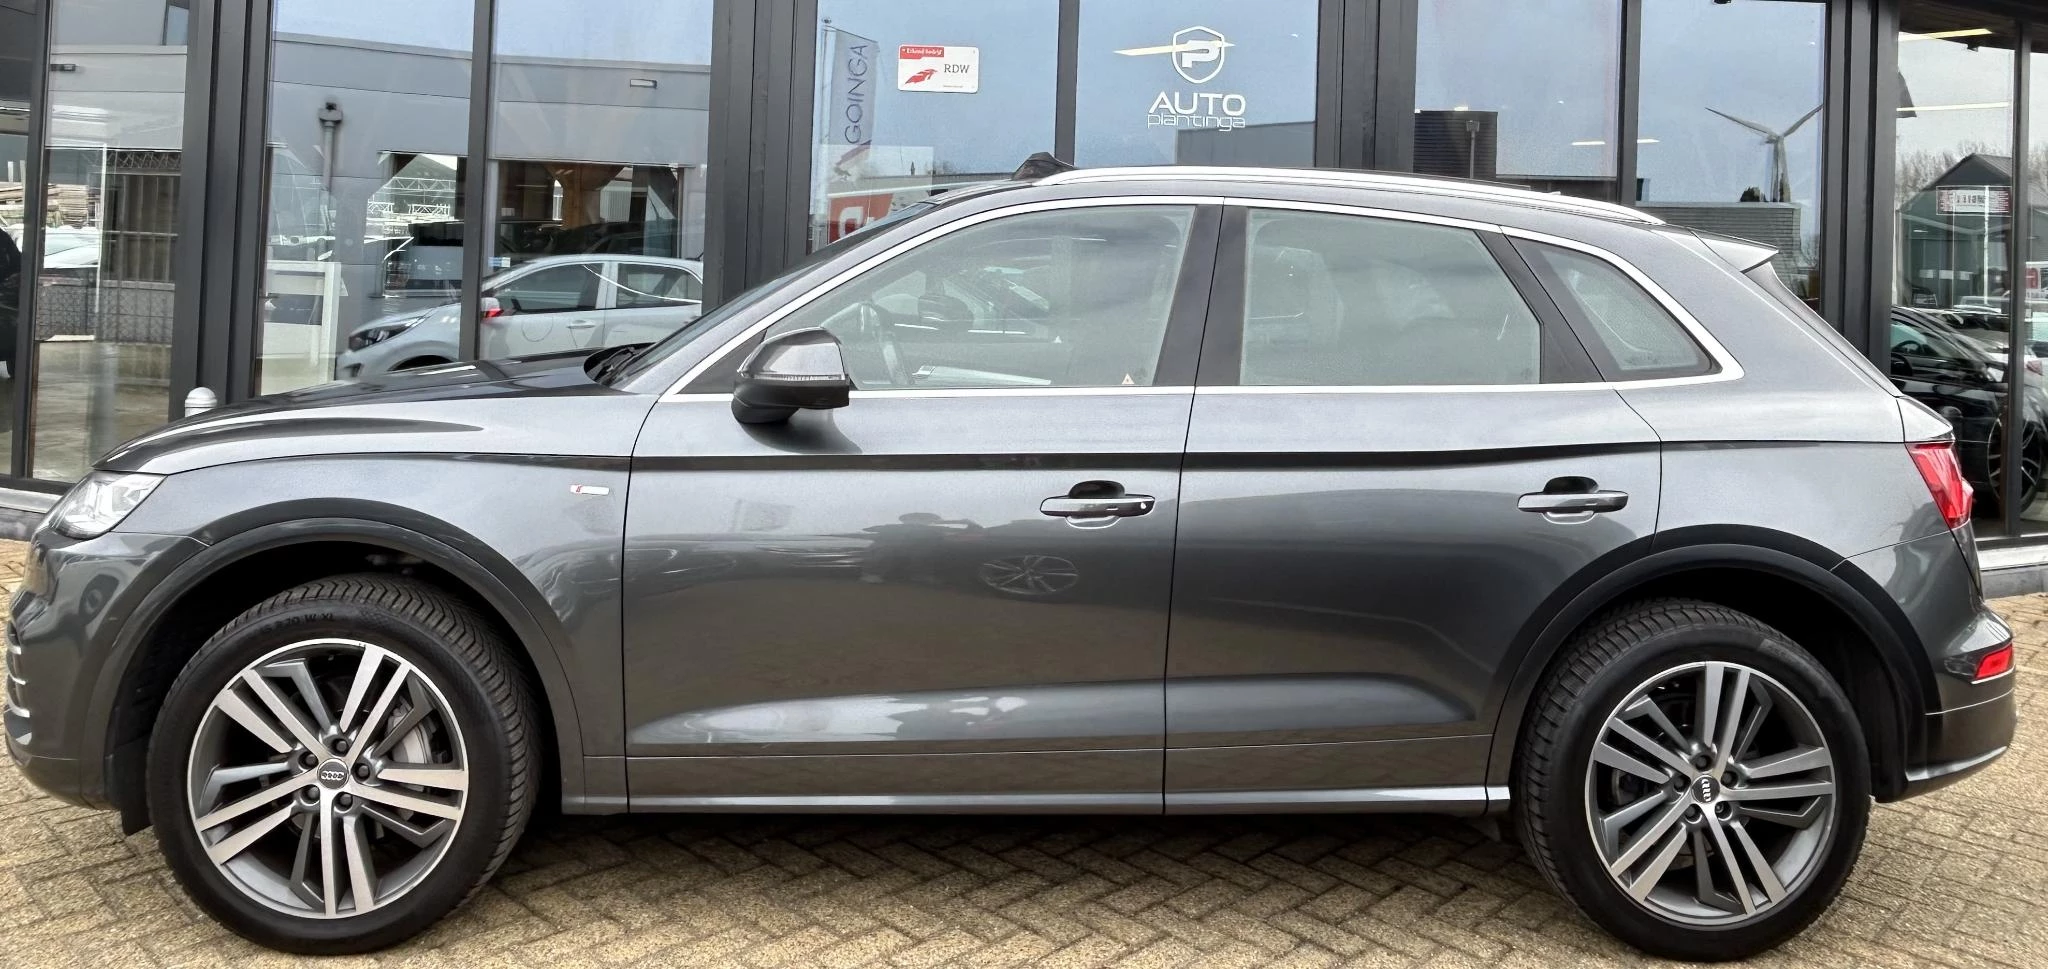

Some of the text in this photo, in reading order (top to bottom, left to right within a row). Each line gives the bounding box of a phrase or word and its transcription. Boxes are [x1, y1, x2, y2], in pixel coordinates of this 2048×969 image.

[944, 64, 970, 73] RDW
[844, 45, 868, 144] GOINGA
[1148, 91, 1246, 116] AUTO
[1147, 113, 1246, 131] plantinga
